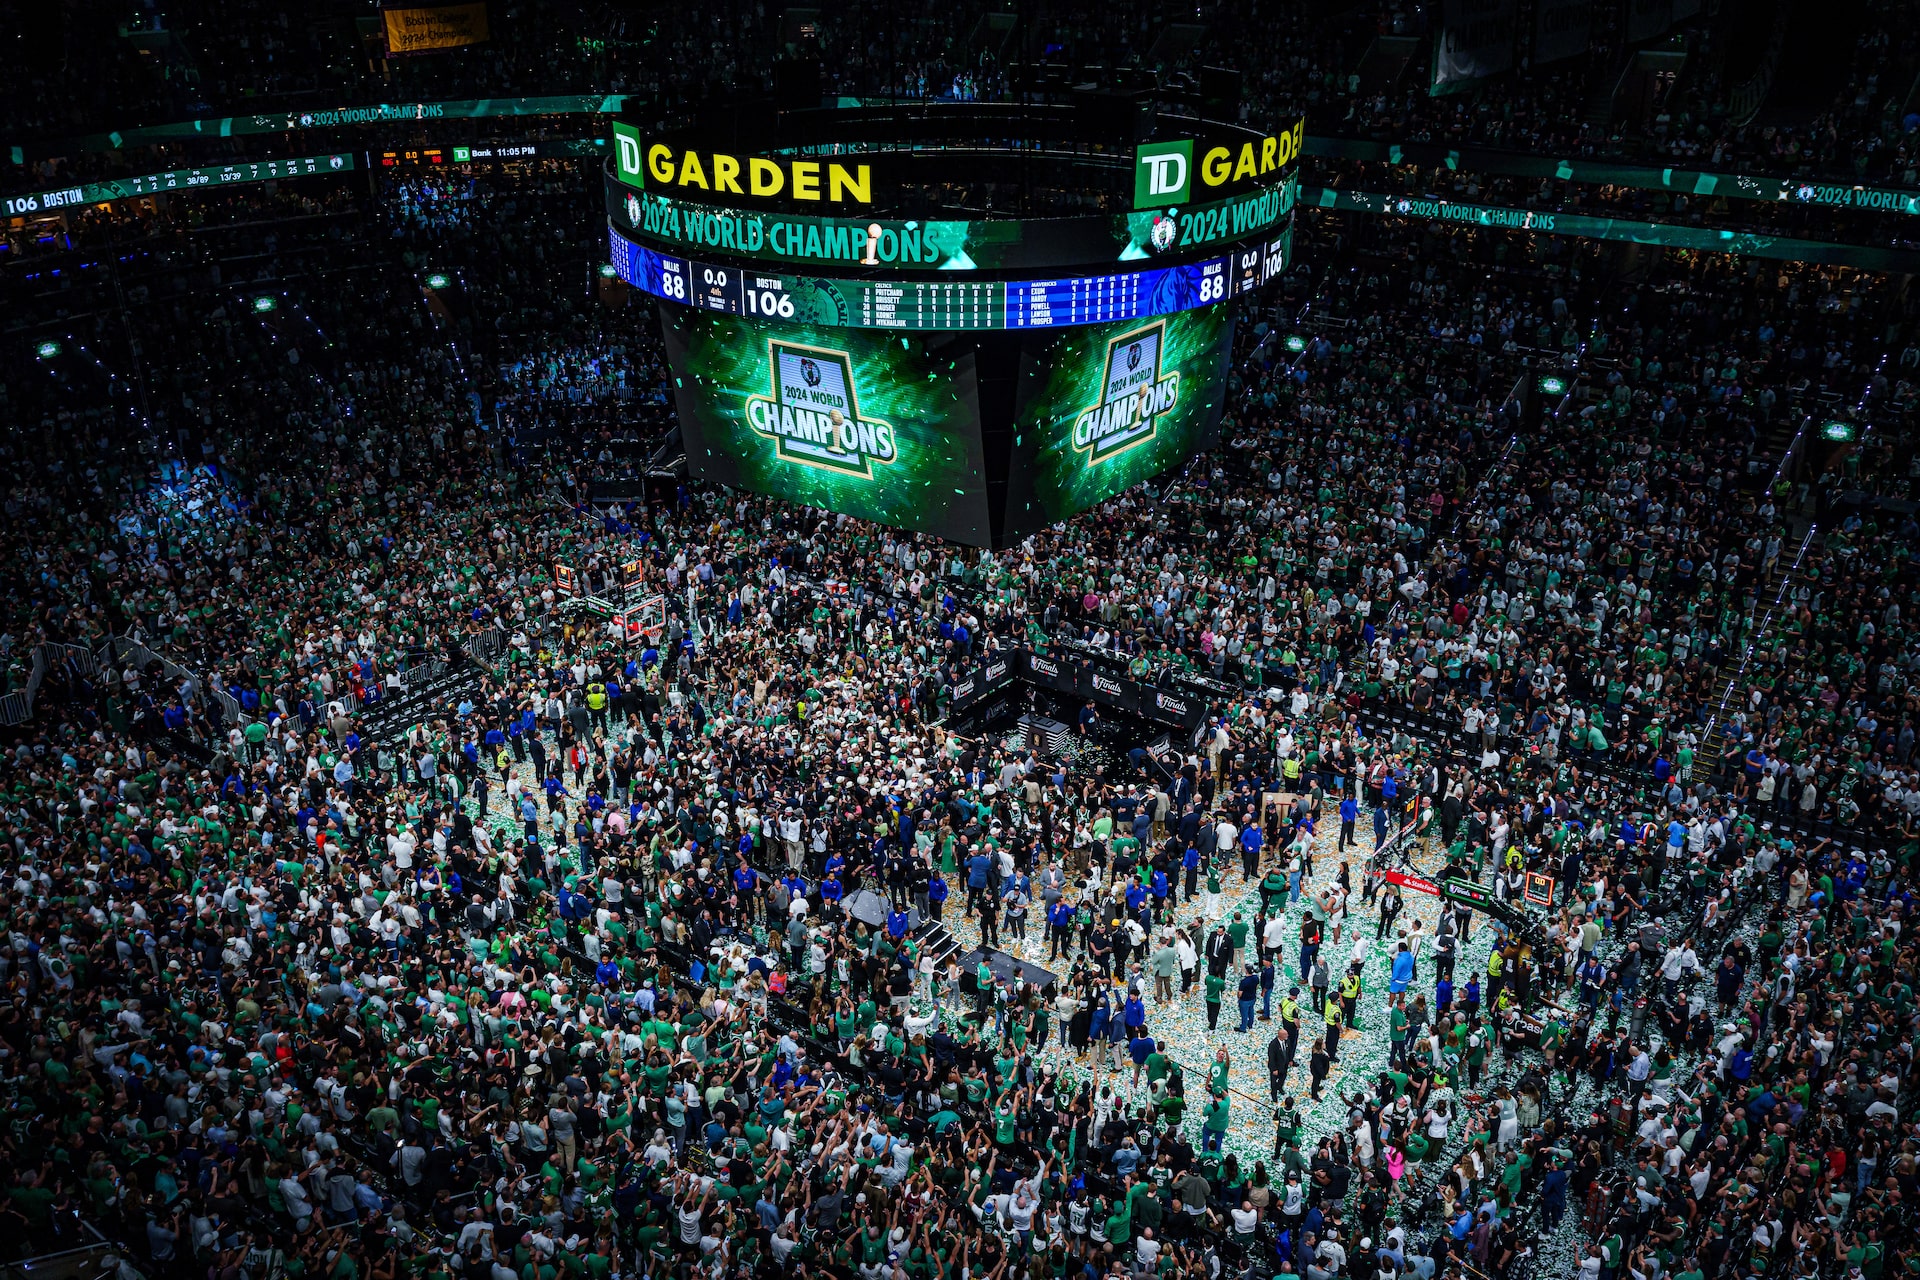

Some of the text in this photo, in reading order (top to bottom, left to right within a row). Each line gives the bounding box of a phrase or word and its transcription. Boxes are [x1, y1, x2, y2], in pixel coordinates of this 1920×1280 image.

[313, 112, 339, 126] 2024
[342, 108, 378, 123] WORLD
[497, 146, 535, 156] 11:05 PM
[615, 132, 640, 176] TD
[219, 172, 241, 181] 13/39
[252, 170, 258, 178] 7
[288, 166, 298, 174] 25
[307, 164, 316, 172] 51
[648, 143, 872, 203] GARDEN
[1141, 152, 1187, 196] TD
[6, 188, 84, 214] 106 BOSTON
[1411, 200, 1439, 217] 2024
[1441, 204, 1481, 222] WORLD
[1815, 186, 1908, 210] 2024 WORLD
[1179, 205, 1228, 247] 2024
[1232, 188, 1278, 236] WORLD
[642, 199, 941, 266] 2024 WORLD CHAMPIONS
[1242, 250, 1257, 269] 0.0
[1265, 250, 1282, 280] 106
[662, 272, 685, 299] 88
[703, 268, 727, 287] 0.0
[756, 277, 782, 290] BOSTON
[1199, 275, 1224, 302] 88
[747, 289, 795, 318] 106
[1110, 367, 1152, 395] 2024 WORLD
[785, 385, 844, 409] 2024 WORLD
[1075, 376, 1177, 446] CHAMPIONS
[749, 399, 893, 458] CHAMPIONS
[1035, 658, 1059, 674] Finals
[1098, 677, 1122, 693] Finals
[1161, 695, 1187, 713] Finals
